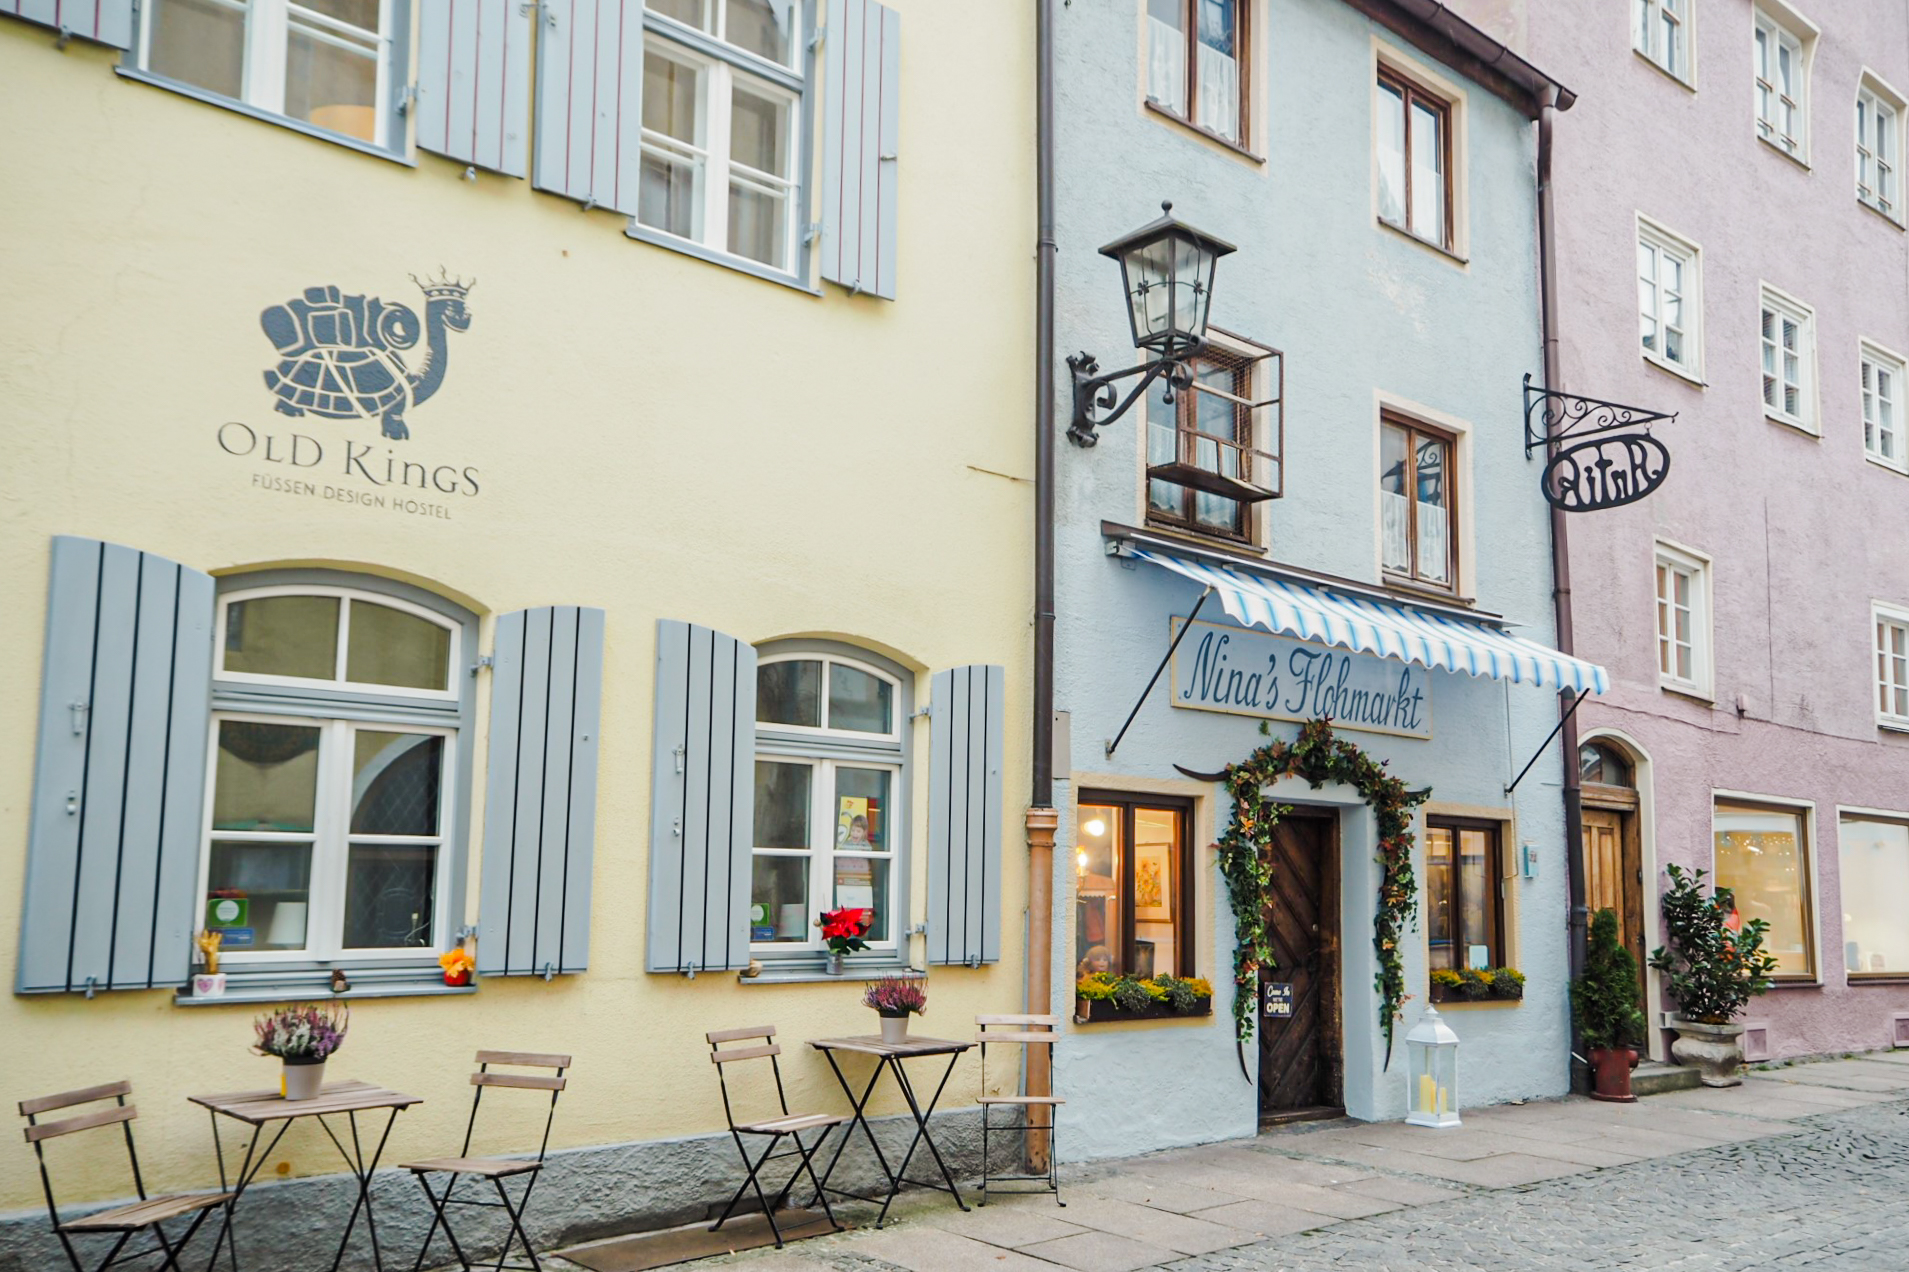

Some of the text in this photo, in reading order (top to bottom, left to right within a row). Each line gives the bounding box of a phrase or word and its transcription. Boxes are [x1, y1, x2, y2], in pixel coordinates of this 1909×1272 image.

[217, 421, 323, 467] OLD
[251, 473, 452, 520] FÜSSEN DESIGN HOSTEL
[1183, 630, 1424, 730] Nina's Flohmarkt
[1266, 1002, 1290, 1014] OPEN
